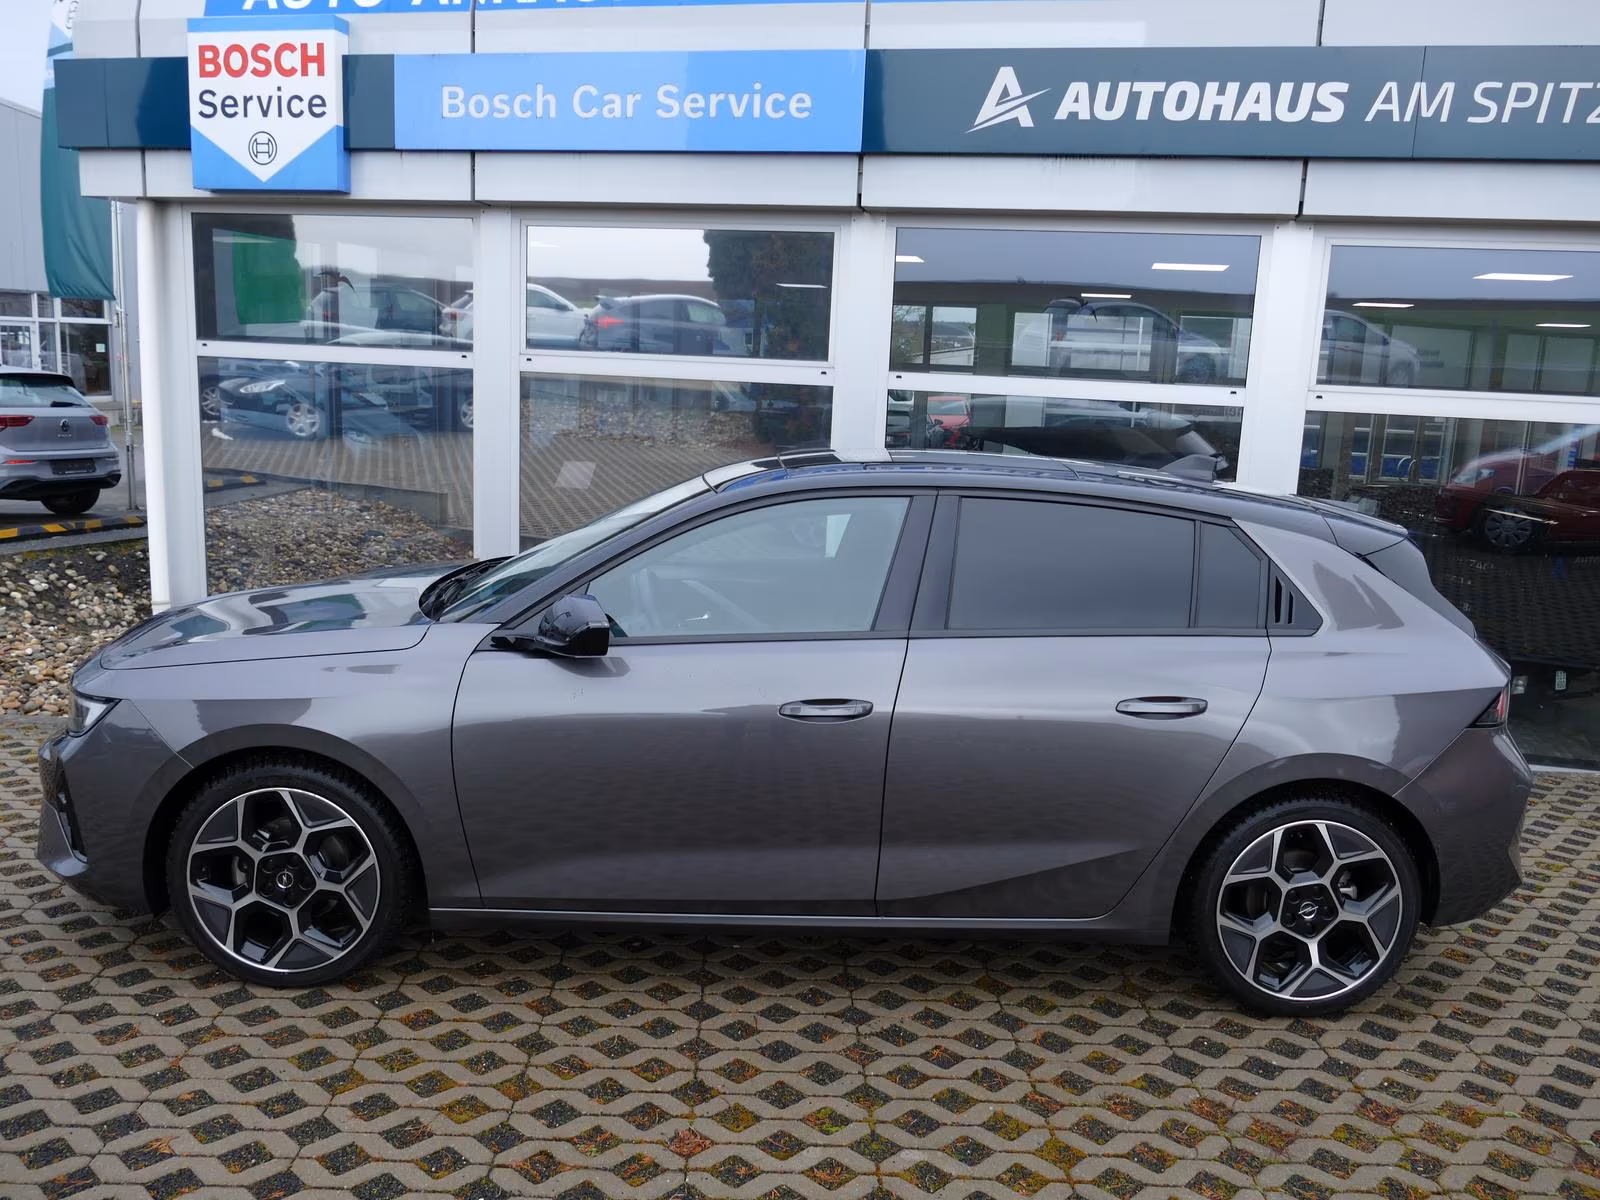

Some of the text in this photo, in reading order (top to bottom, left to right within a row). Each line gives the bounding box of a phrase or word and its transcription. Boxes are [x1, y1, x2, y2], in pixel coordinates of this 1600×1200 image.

[198, 42, 325, 78] BOSCH
[198, 86, 327, 119] Service
[441, 81, 813, 119] Bosch Car Service
[1054, 81, 1350, 123] AUTOHAUS
[1364, 81, 1456, 123] AM
